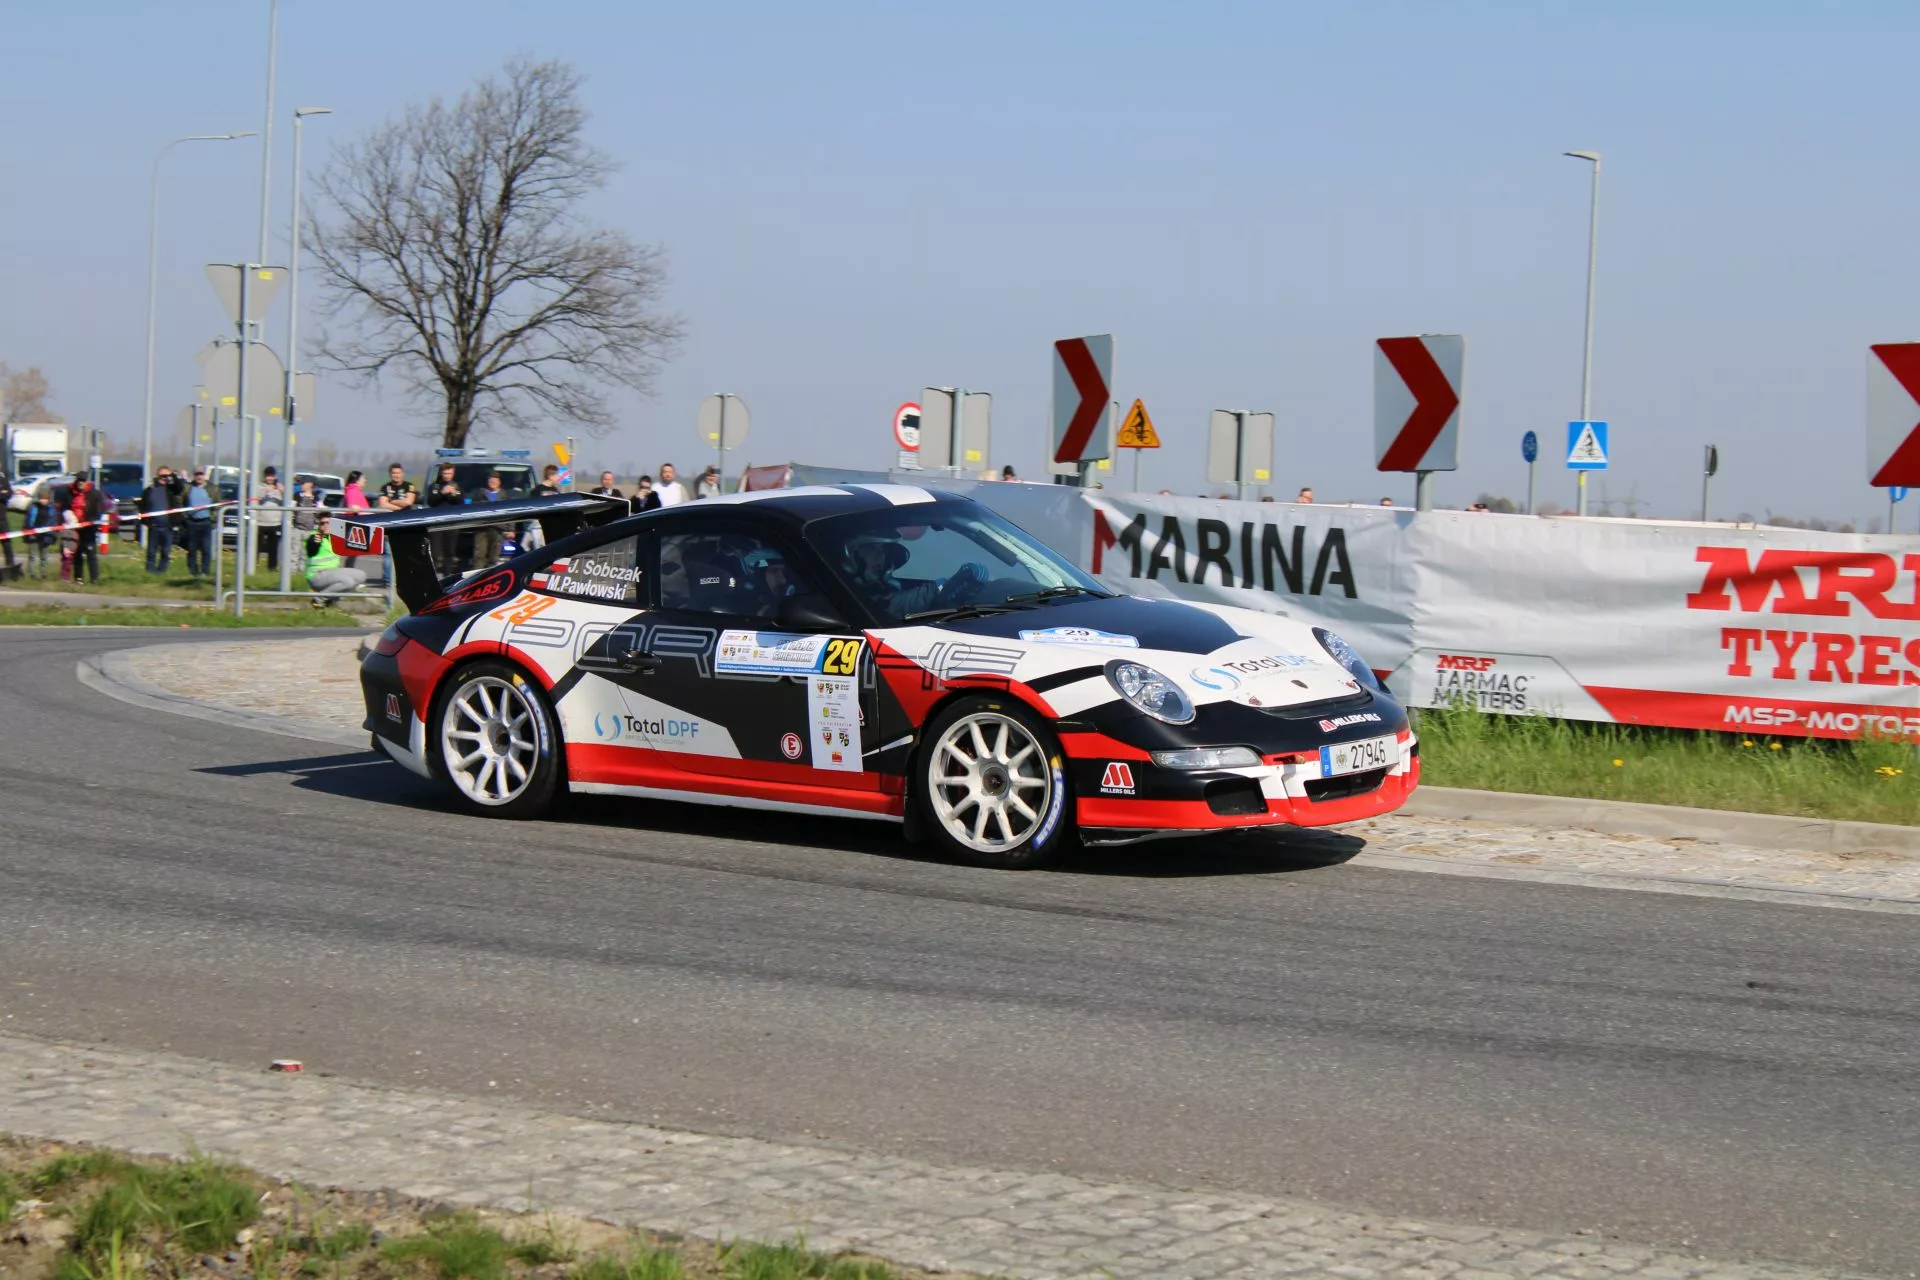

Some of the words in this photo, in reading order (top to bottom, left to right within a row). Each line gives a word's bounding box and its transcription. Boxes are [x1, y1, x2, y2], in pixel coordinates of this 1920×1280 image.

[1092, 509, 1358, 598] MARINA
[567, 564, 579, 575] J.
[582, 559, 643, 583] Sobczak
[547, 574, 629, 601] M.Pawłowski
[1686, 547, 1920, 621] MR
[489, 594, 557, 625] 29
[1063, 629, 1090, 637] 29
[823, 640, 860, 675] 29
[1221, 656, 1286, 674] Total
[1436, 654, 1497, 672] MRF
[624, 715, 665, 736] Total
[667, 719, 700, 739] DPF
[1331, 713, 1367, 728] MILLERS
[1363, 713, 1382, 722] OILS
[1351, 740, 1387, 769] 27946
